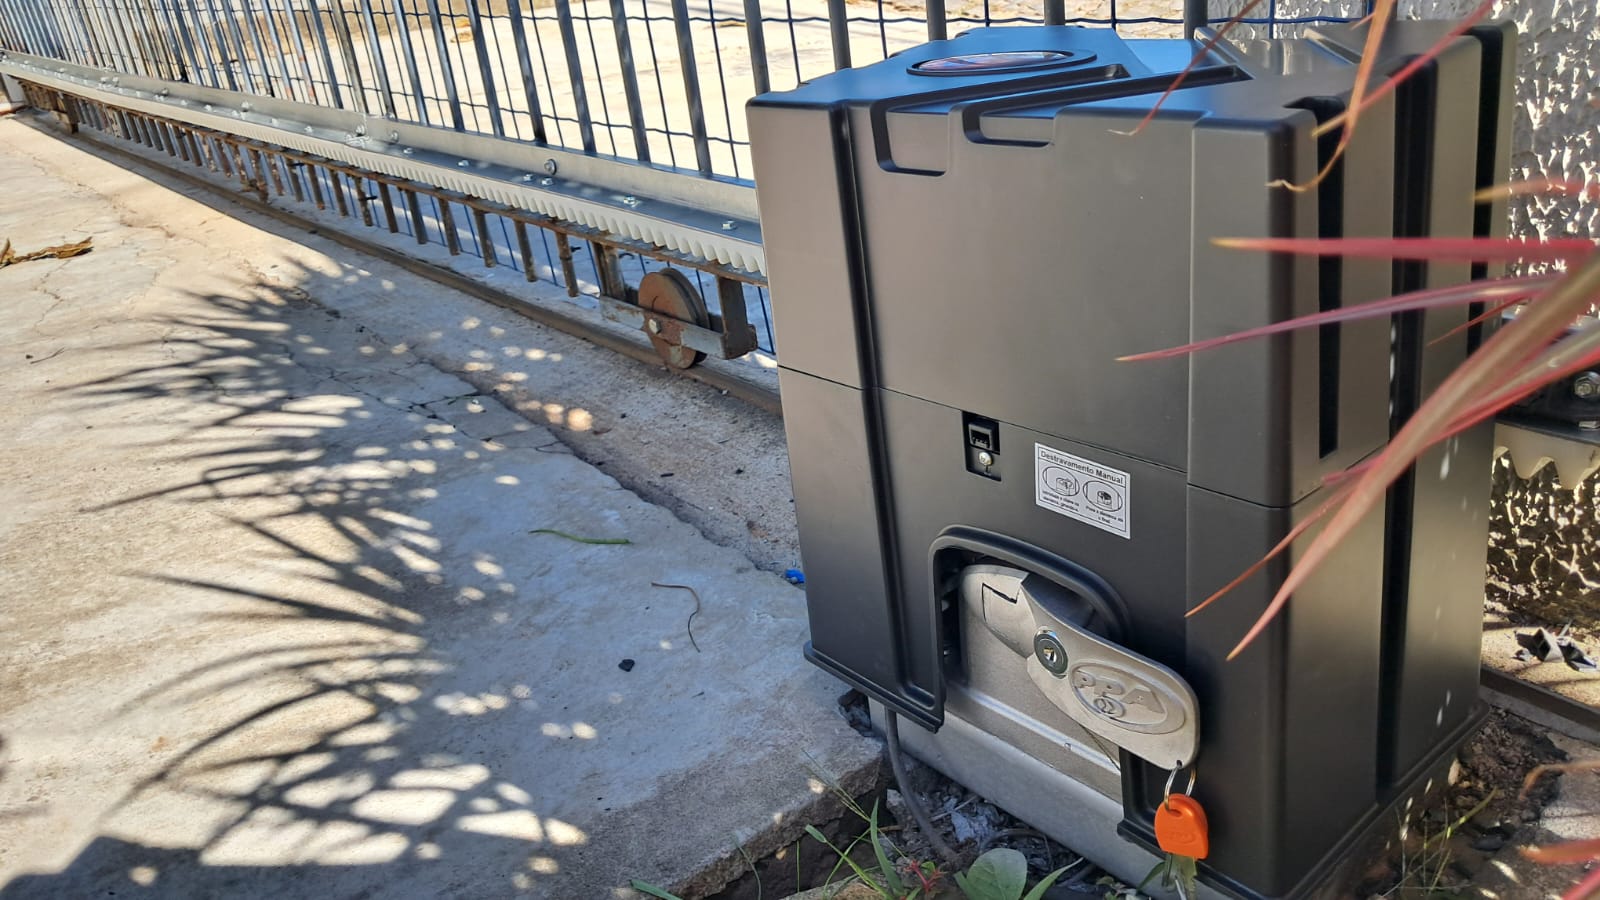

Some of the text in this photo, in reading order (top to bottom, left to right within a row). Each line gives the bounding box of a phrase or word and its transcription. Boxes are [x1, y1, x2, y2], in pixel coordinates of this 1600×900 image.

[1041, 450, 1123, 484] Destravamento Manual
[1073, 670, 1166, 714] PPA
